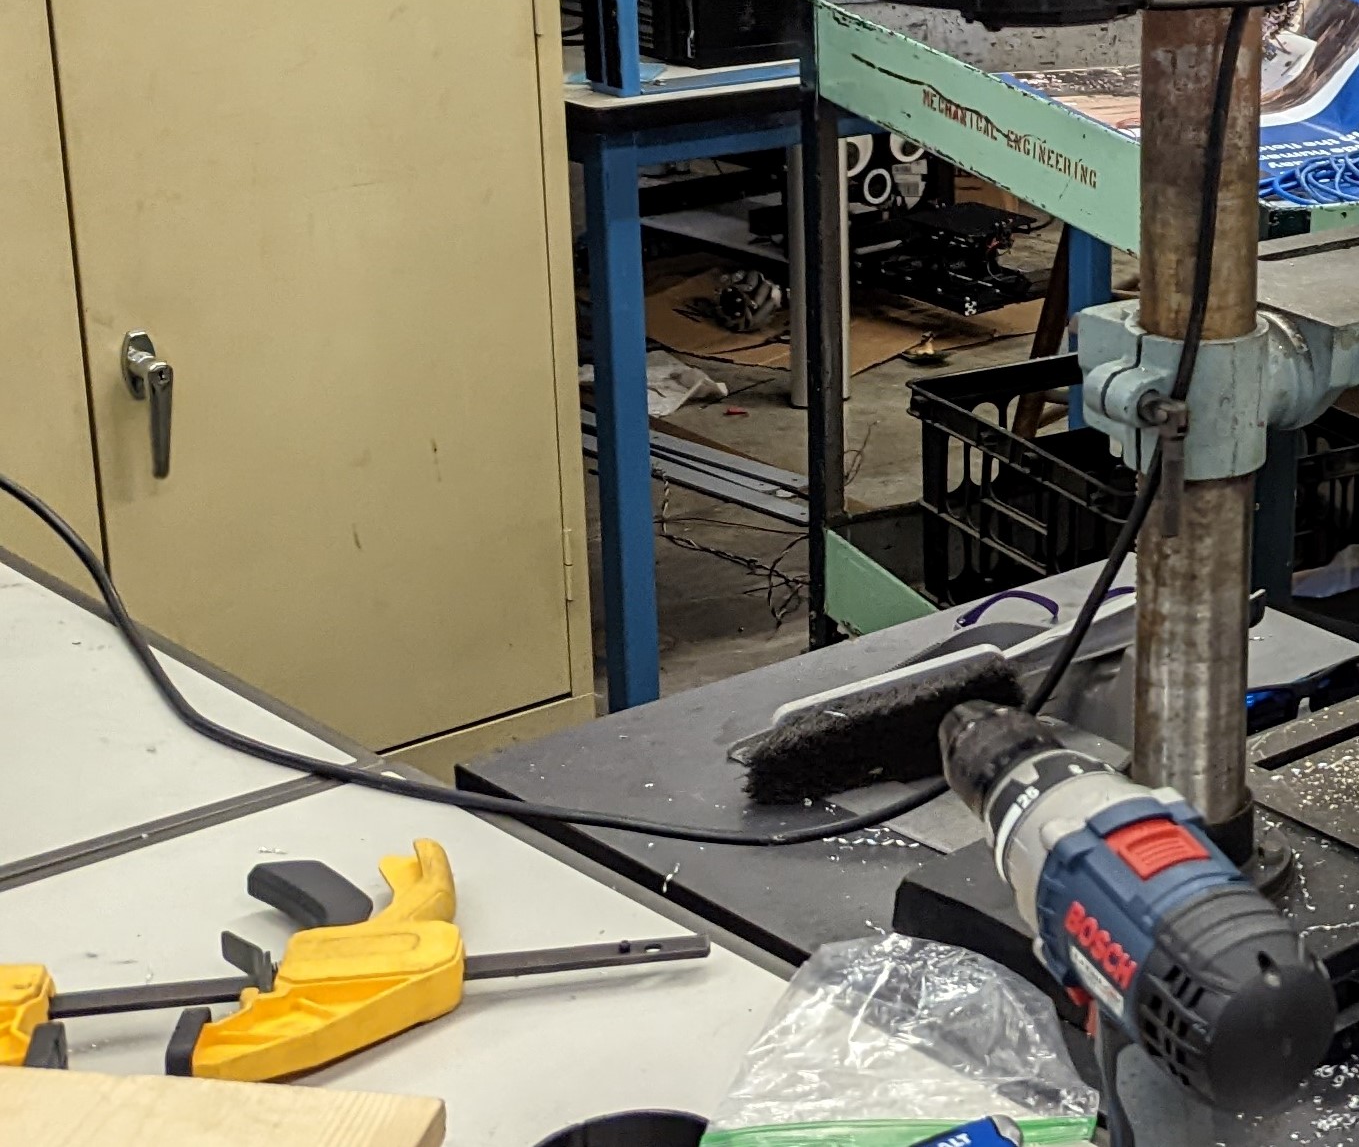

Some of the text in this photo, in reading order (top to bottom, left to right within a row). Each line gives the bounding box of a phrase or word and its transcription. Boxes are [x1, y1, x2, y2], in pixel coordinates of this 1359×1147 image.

[922, 89, 1097, 189] MECHANICAL ENGINEERING
[1065, 900, 1138, 990] BOSCH
